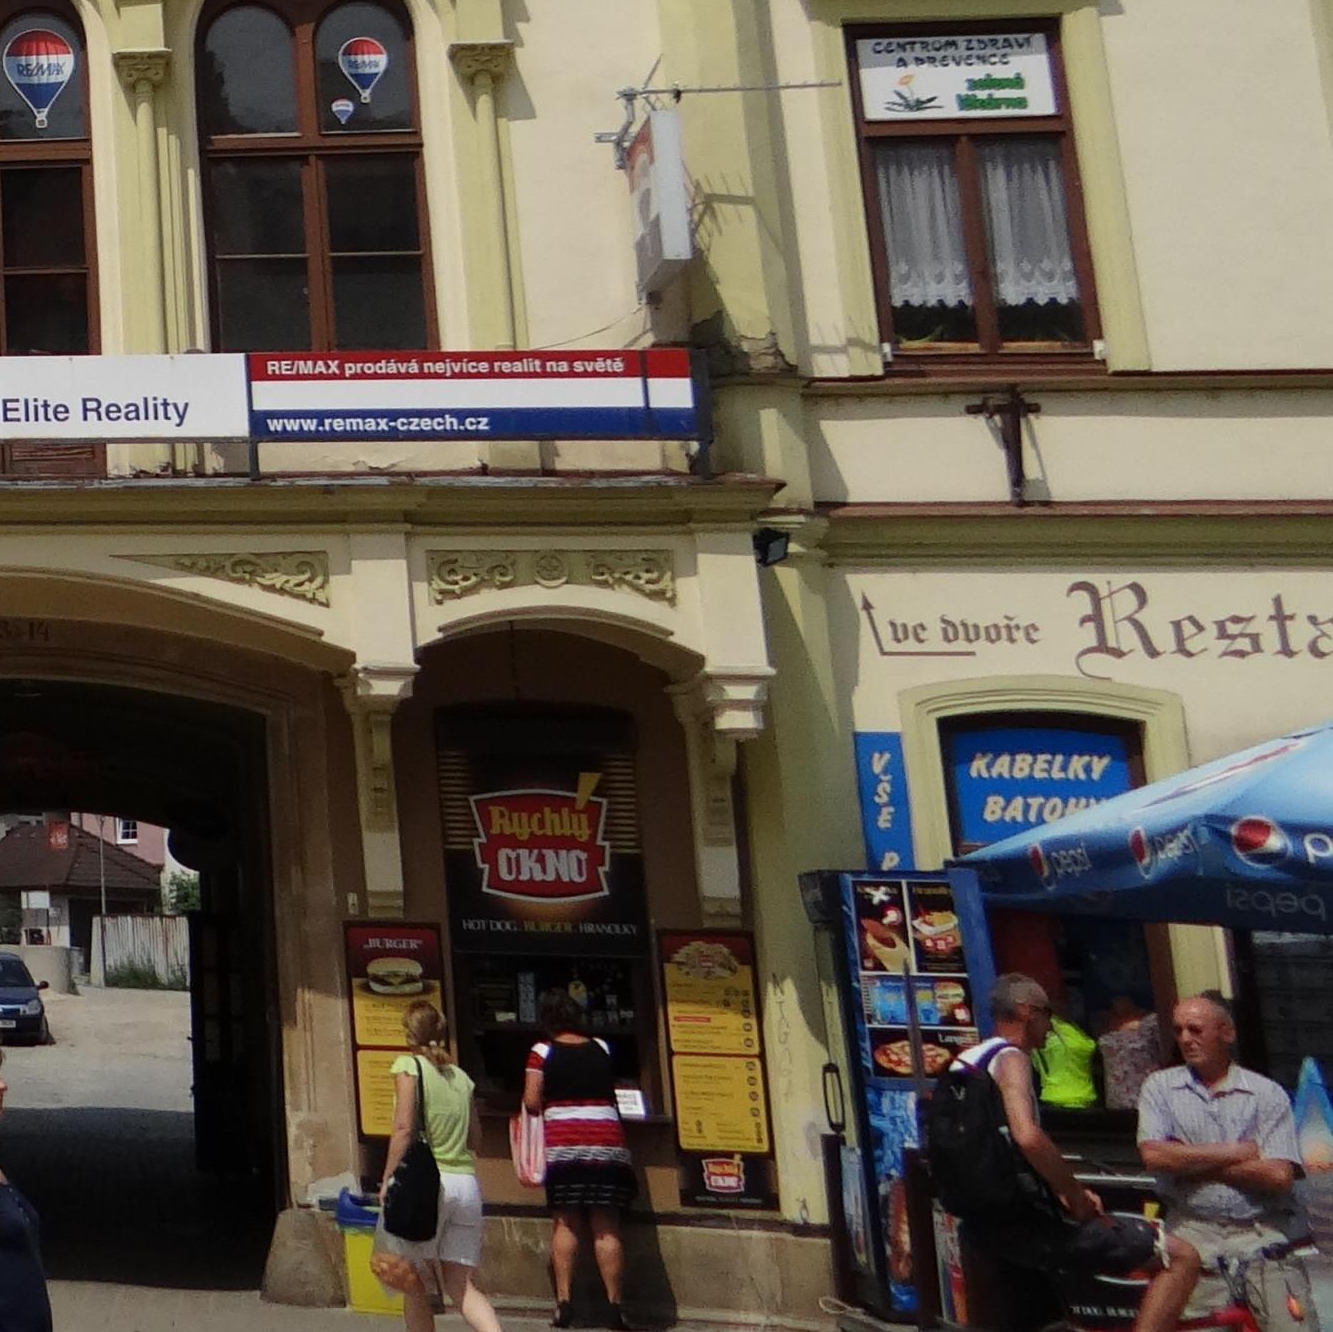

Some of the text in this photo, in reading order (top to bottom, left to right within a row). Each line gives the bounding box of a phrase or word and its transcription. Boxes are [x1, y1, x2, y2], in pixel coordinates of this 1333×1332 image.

[896, 53, 1010, 68] A PREVENCE
[267, 356, 626, 378] RE/MAX prodává nejvíce realit na světě
[2, 396, 71, 423] Elite
[81, 395, 190, 428] Reality
[266, 414, 490, 433] www.remax-czech.cz
[889, 614, 1041, 646] ve dvoře
[969, 752, 1112, 780] KABELKY
[983, 795, 1110, 824] BATOH
[497, 846, 589, 884] OKNO
[489, 919, 518, 933] DOG
